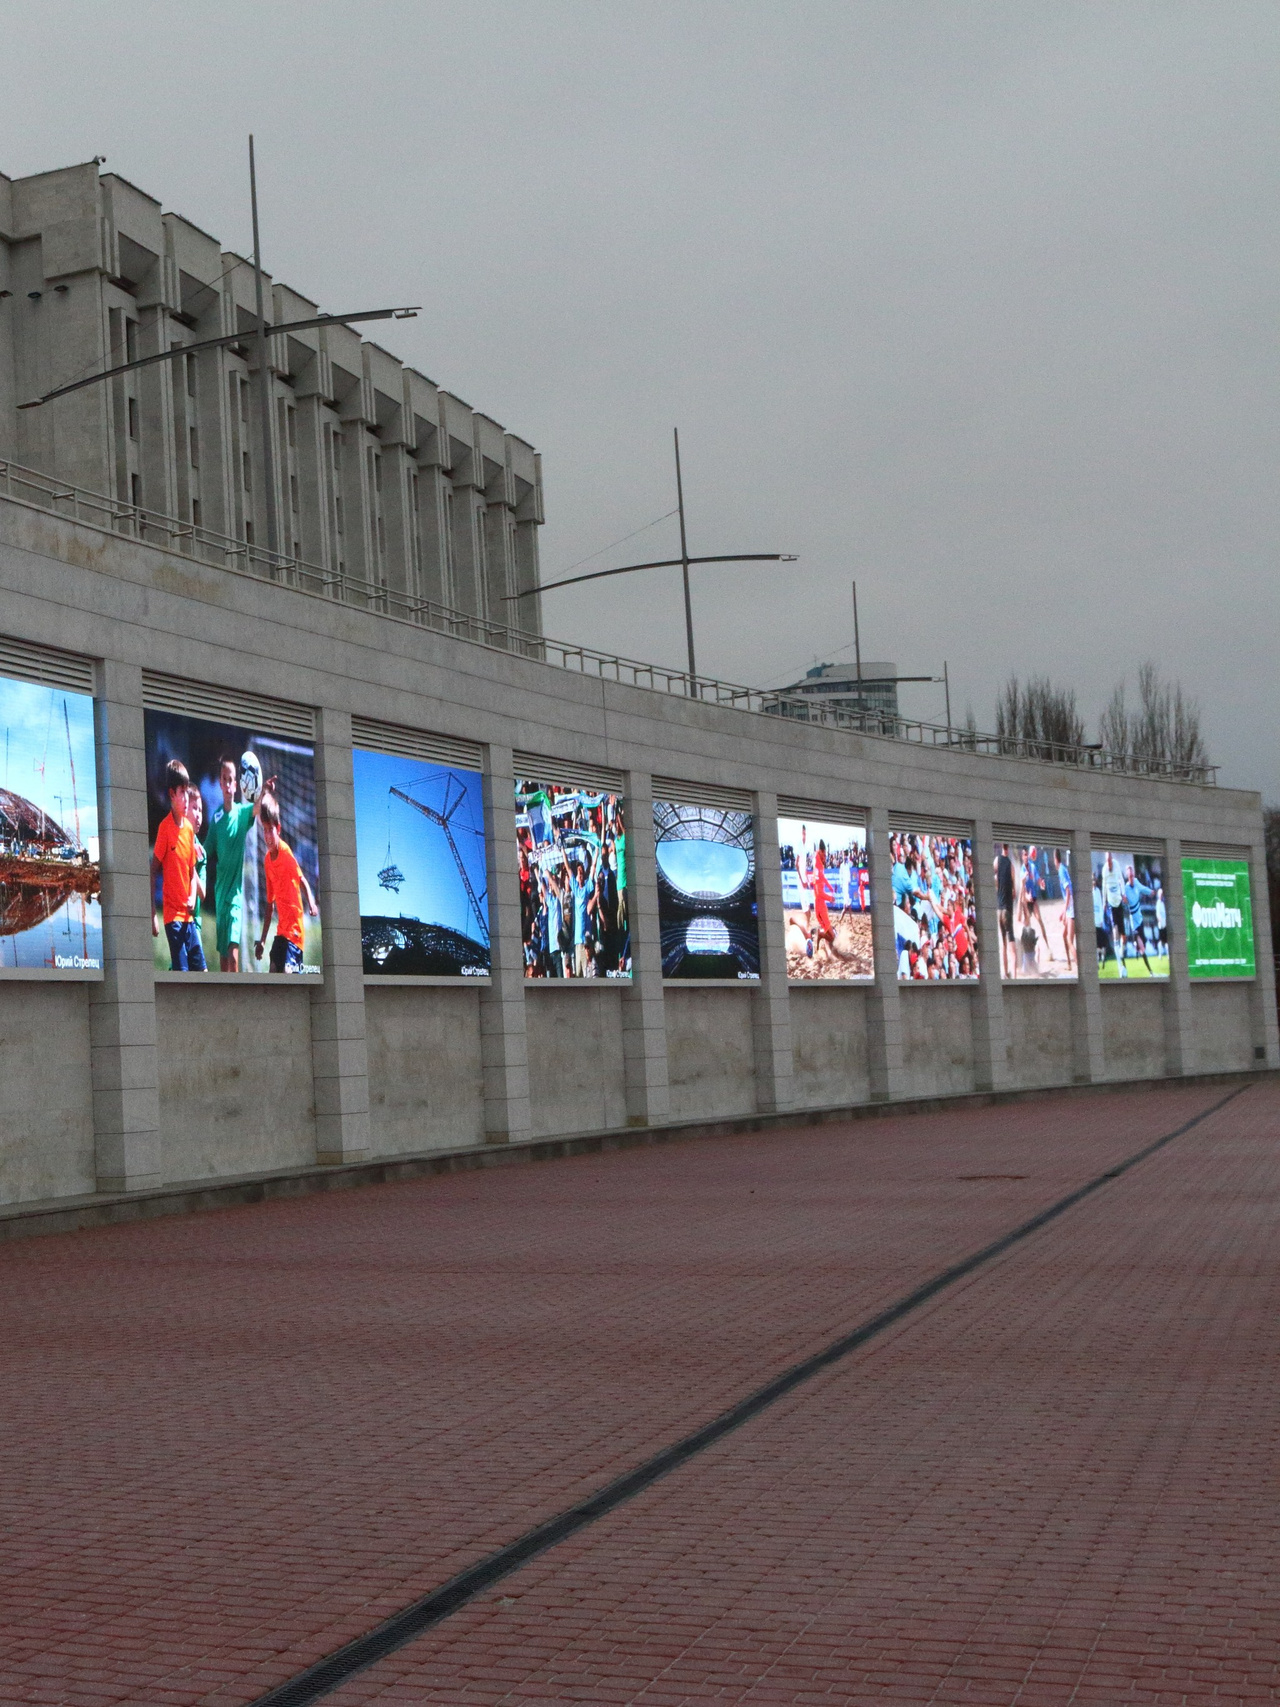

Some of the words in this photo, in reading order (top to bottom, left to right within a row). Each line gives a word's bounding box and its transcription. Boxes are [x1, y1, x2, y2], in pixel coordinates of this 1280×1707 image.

[1192, 901, 1242, 928] ФотоМатч
[54, 954, 73, 969] Юрий
[73, 955, 100, 970] Стрелец
